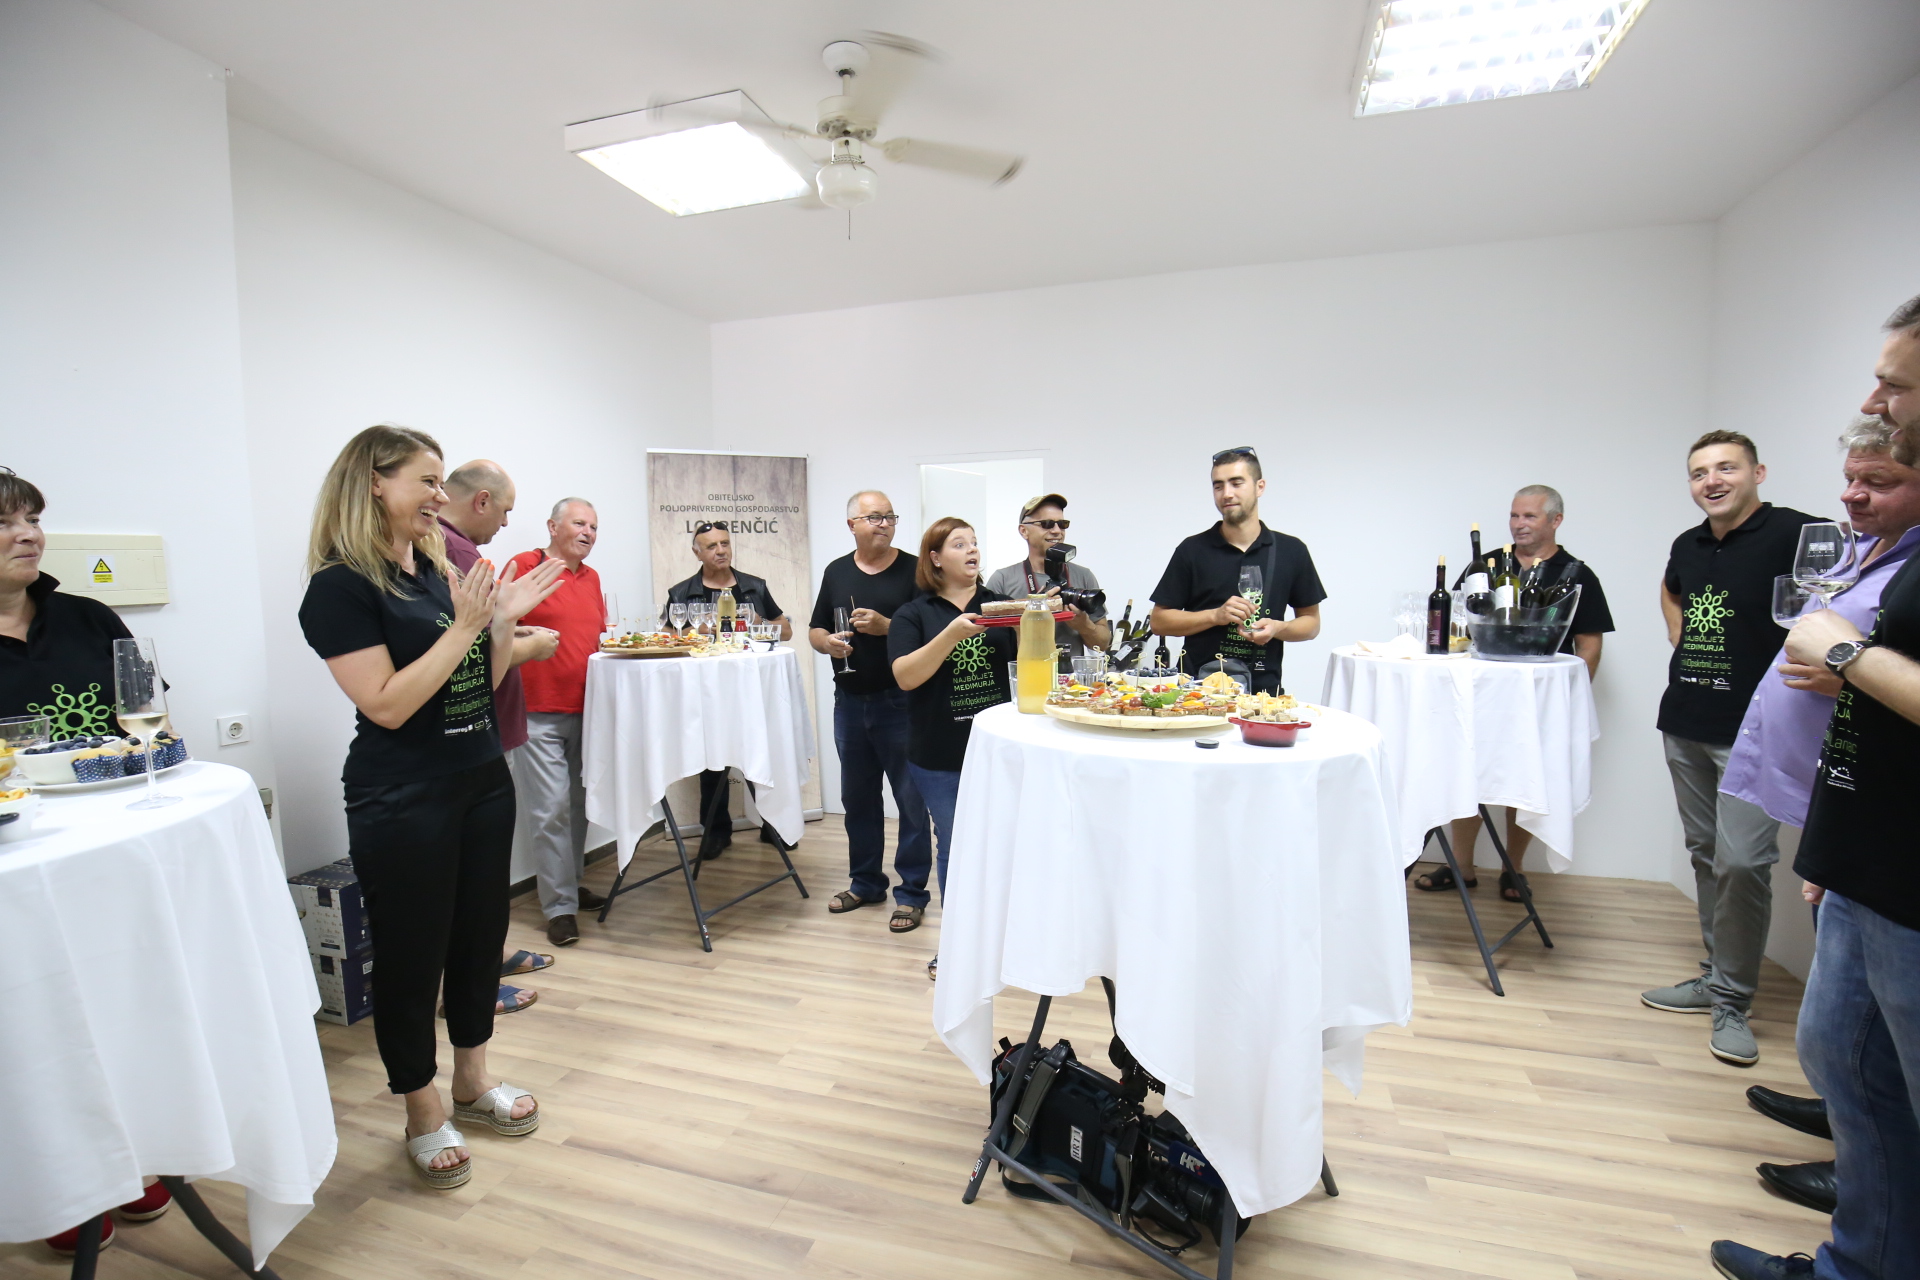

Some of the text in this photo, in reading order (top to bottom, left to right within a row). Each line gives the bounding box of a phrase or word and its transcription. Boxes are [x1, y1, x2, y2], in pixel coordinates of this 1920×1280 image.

[707, 493, 755, 502] OBITELJSKO
[659, 504, 800, 514] POLJOPRIVREDNO GOSPODARSTVO
